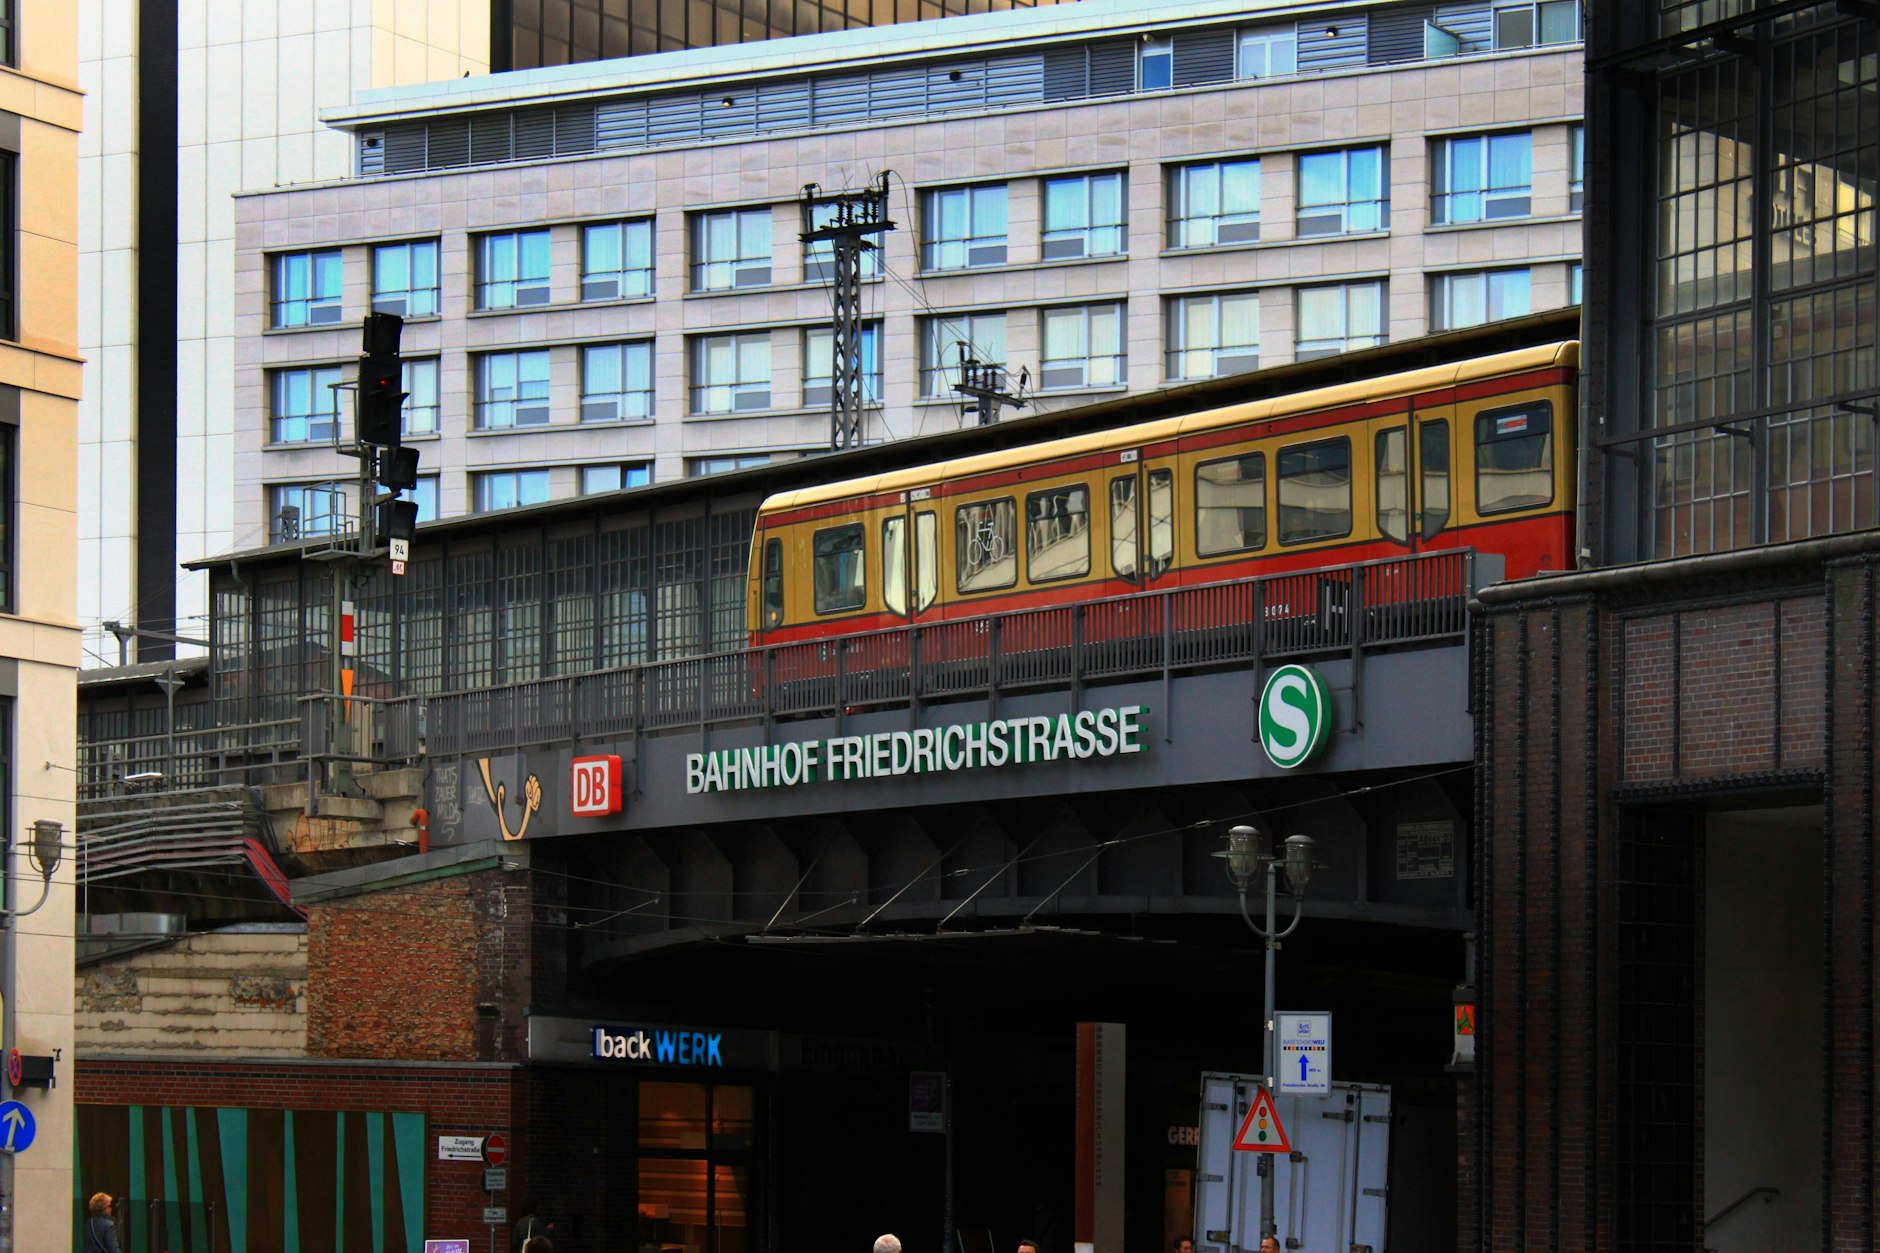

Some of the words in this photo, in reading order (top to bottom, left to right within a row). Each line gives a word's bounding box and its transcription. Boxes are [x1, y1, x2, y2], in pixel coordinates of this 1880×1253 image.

[394, 544, 404, 555] 94
[1268, 674, 1310, 761] S
[687, 741, 823, 794] BAHNHOF
[827, 706, 1143, 781] FRIEDRICHSTRASSE
[577, 766, 606, 807] DB
[599, 1028, 651, 1059] back
[655, 1029, 722, 1067] WERK
[454, 1138, 474, 1146] Zugang
